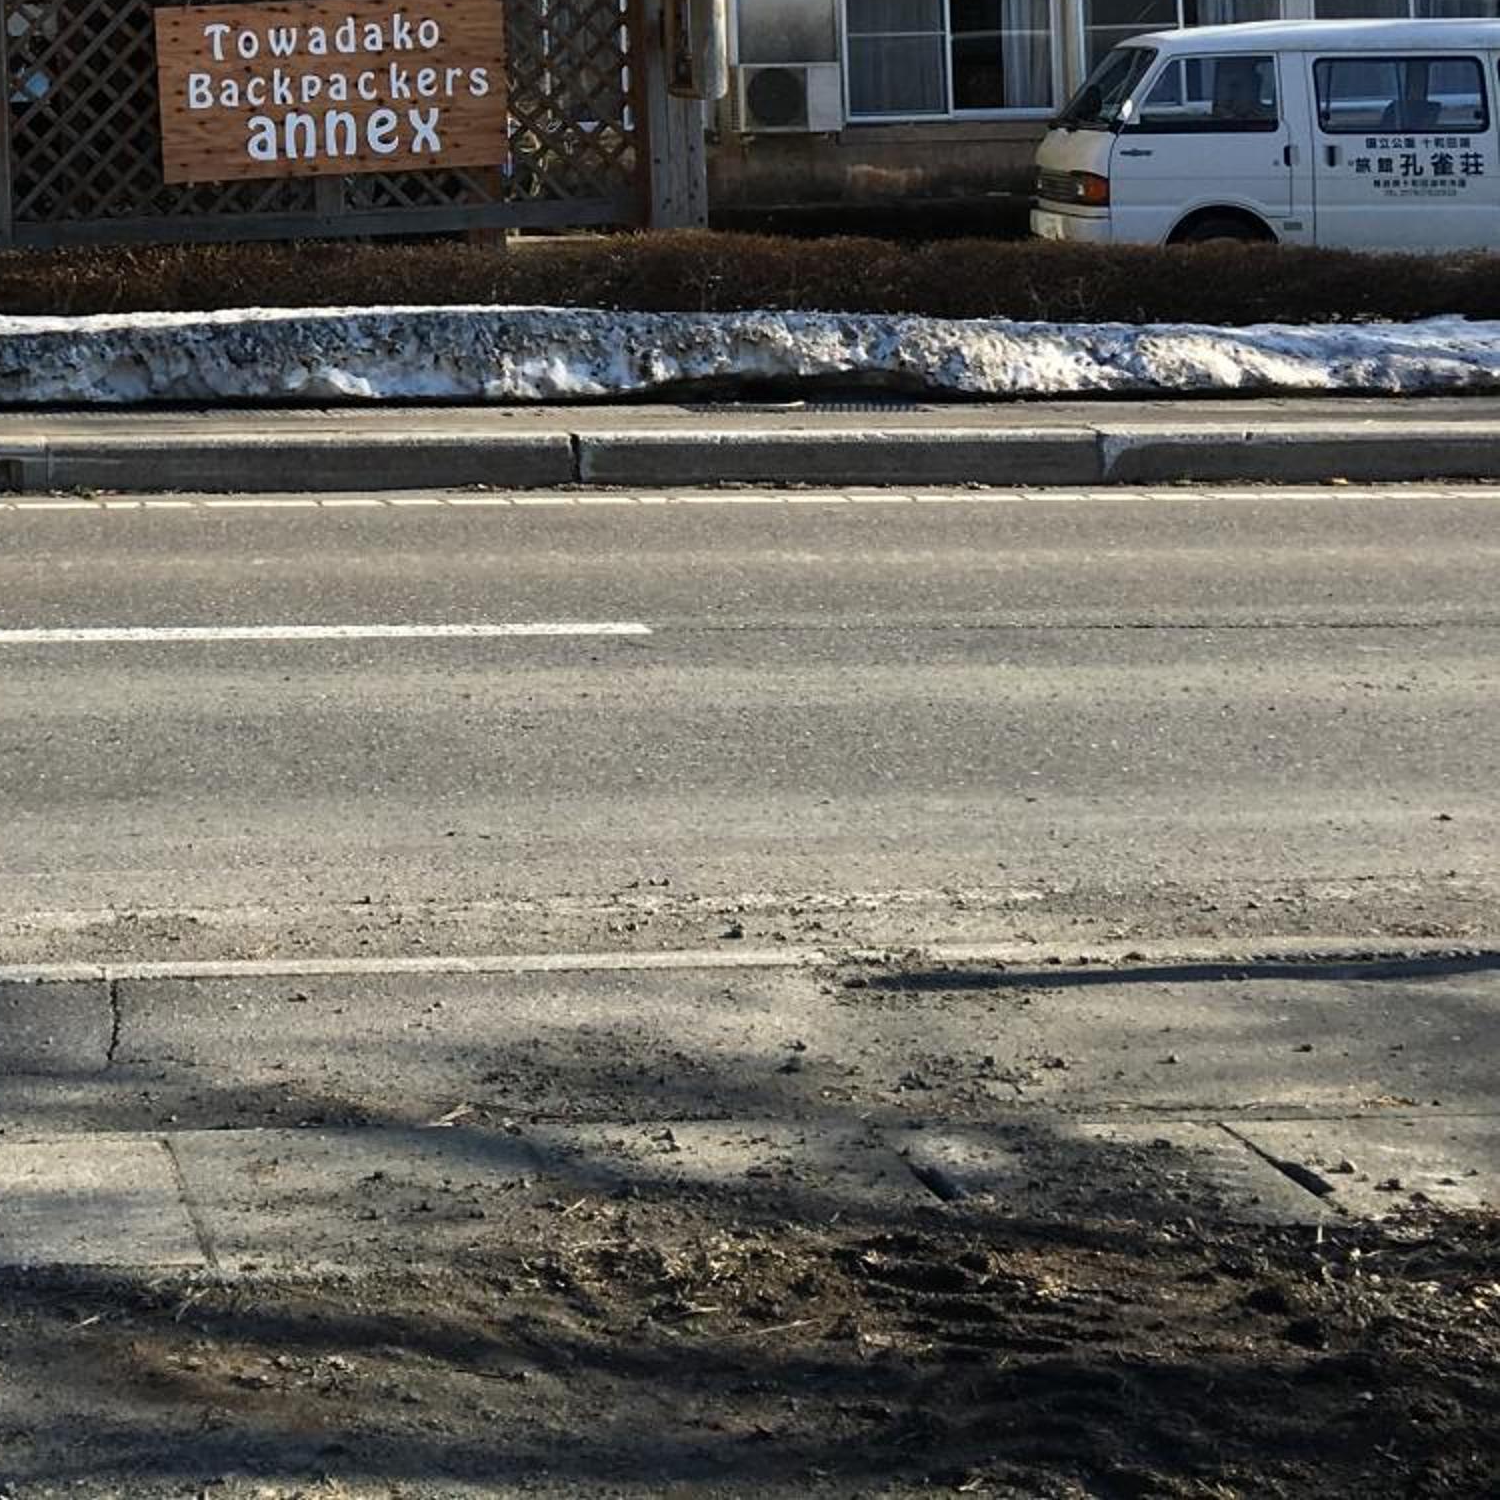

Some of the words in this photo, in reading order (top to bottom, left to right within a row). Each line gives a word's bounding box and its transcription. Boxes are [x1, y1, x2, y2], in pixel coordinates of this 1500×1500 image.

[204, 13, 440, 61] Towadako
[188, 62, 490, 110] Backpackers
[247, 107, 442, 161] annex
